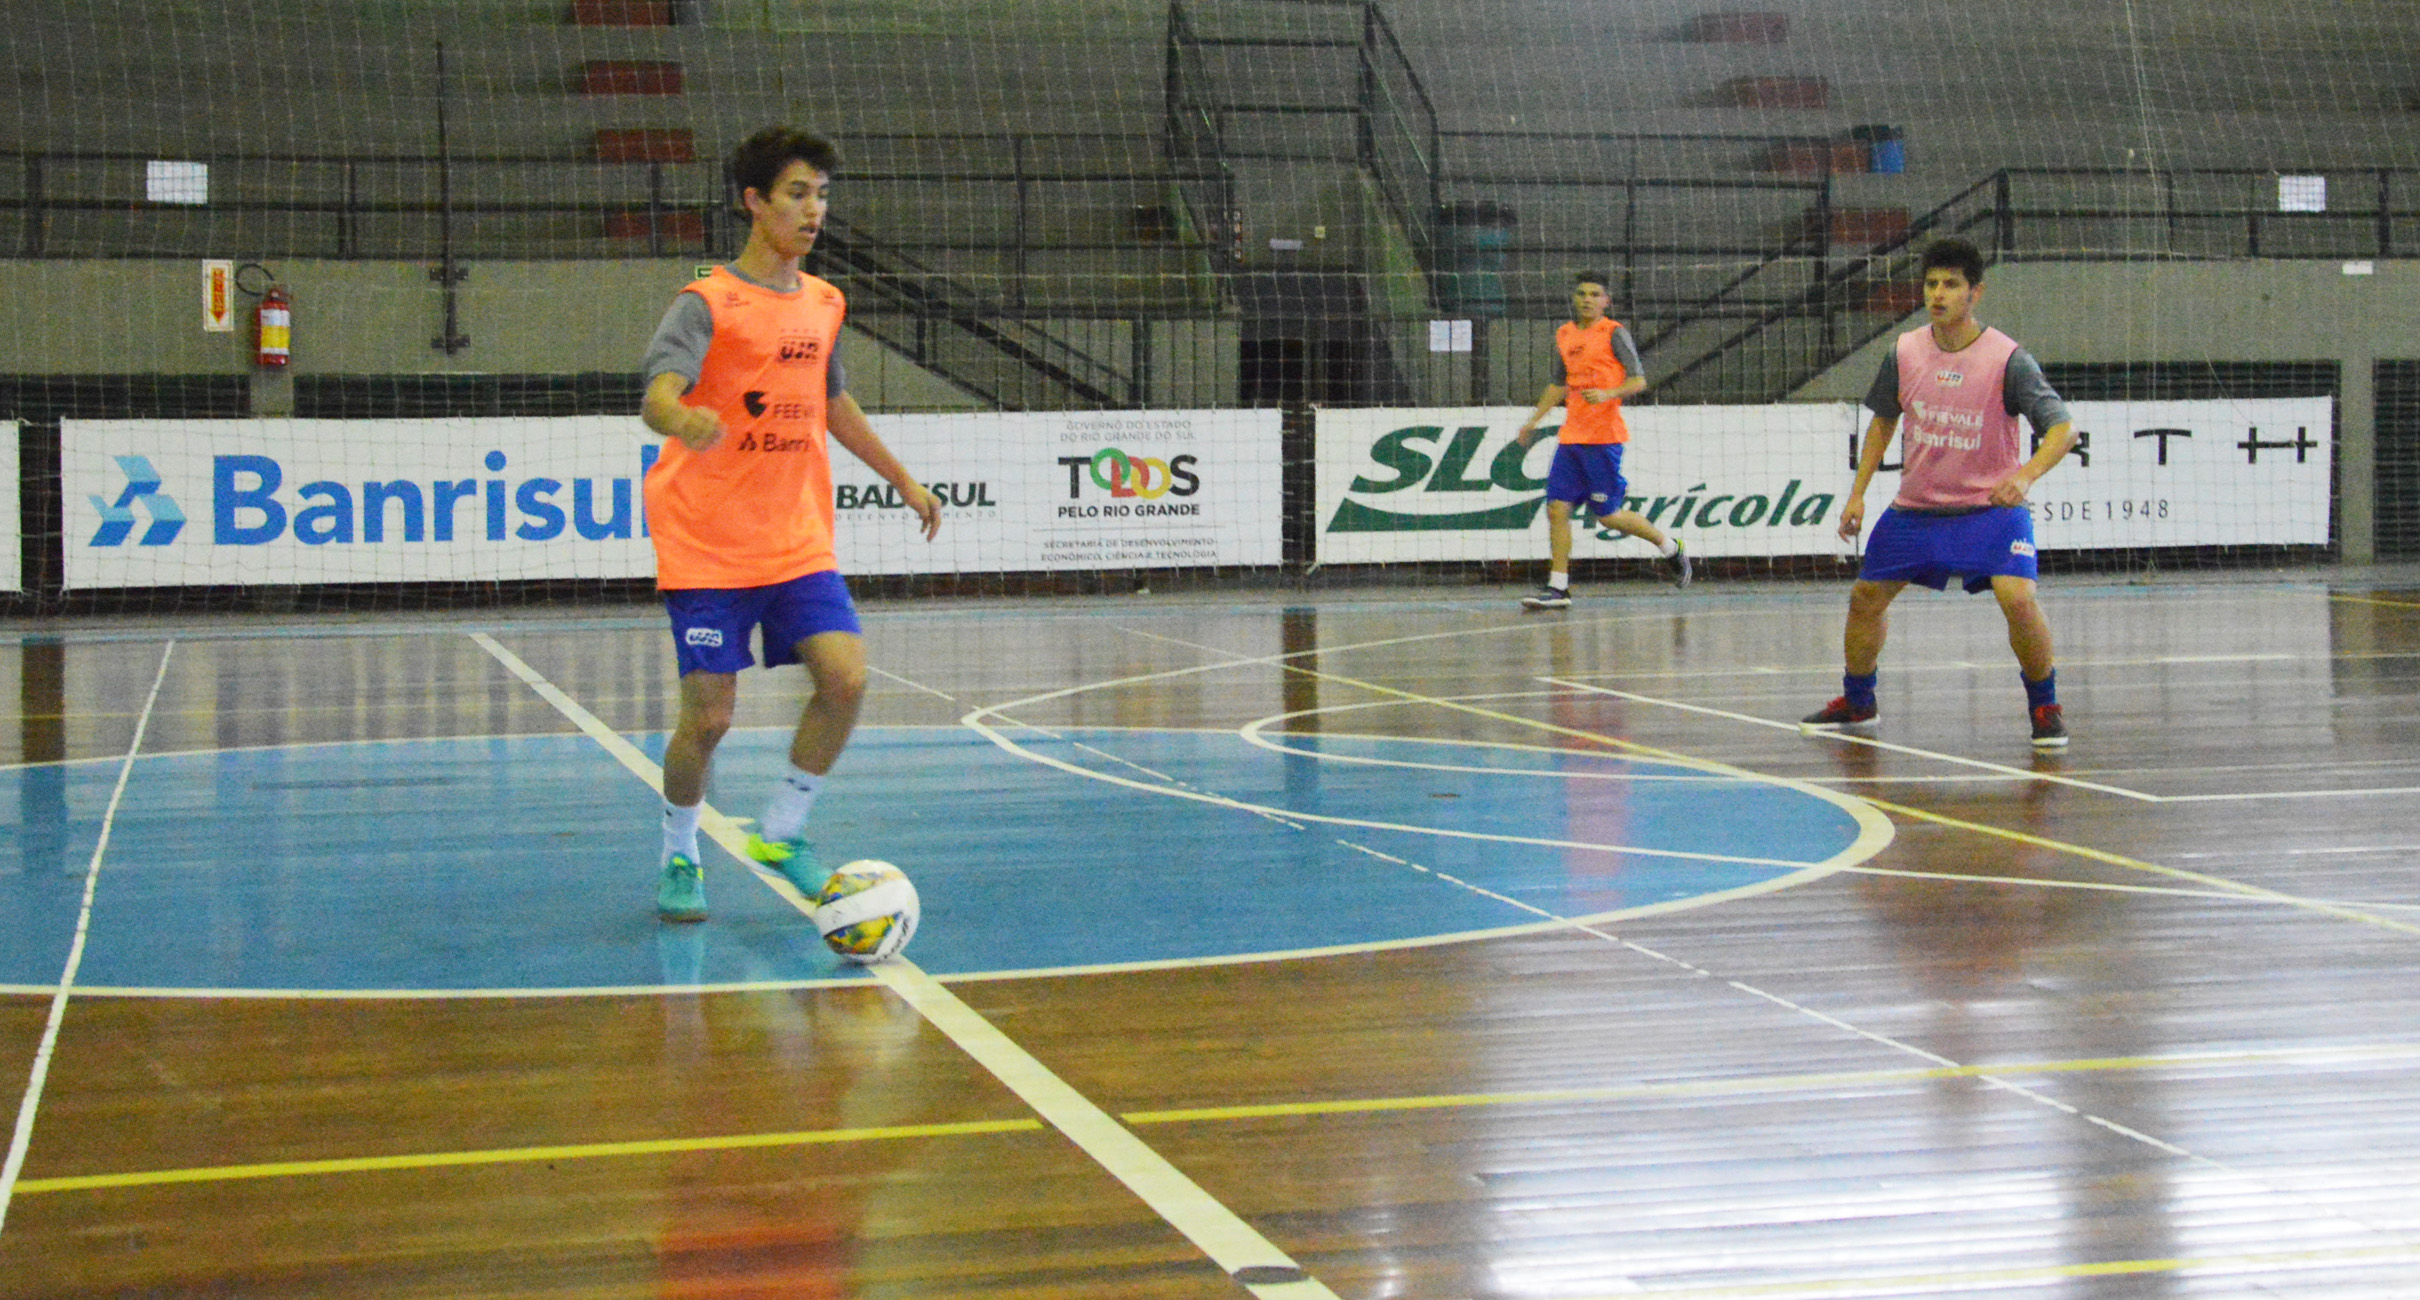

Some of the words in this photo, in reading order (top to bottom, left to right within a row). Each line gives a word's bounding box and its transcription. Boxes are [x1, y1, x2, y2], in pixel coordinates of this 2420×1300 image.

[1066, 420, 1122, 431] GOVERNO
[1126, 420, 1144, 429] DO
[1147, 420, 1192, 429] ESTADO
[1060, 432, 1078, 442] DO
[1081, 432, 1101, 441] RIO
[1105, 431, 1151, 441] GRANDE
[1155, 430, 1172, 440] DO
[1176, 430, 1195, 440] SUL
[1349, 425, 1560, 493] SLC
[1058, 447, 1200, 499] TODOS
[836, 482, 996, 509] BADSUL
[835, 510, 996, 521] DESENVOMENTO
[1058, 505, 1098, 518] PELO
[1103, 505, 1130, 517] RIO
[1135, 503, 1200, 517] GRANDE
[2028, 501, 2092, 521] ESDE
[2105, 499, 2169, 520] 1948
[1044, 540, 1103, 549] SECRETARIA
[1106, 539, 1117, 548] DE
[1156, 549, 1217, 559] TECNOLOGIA
